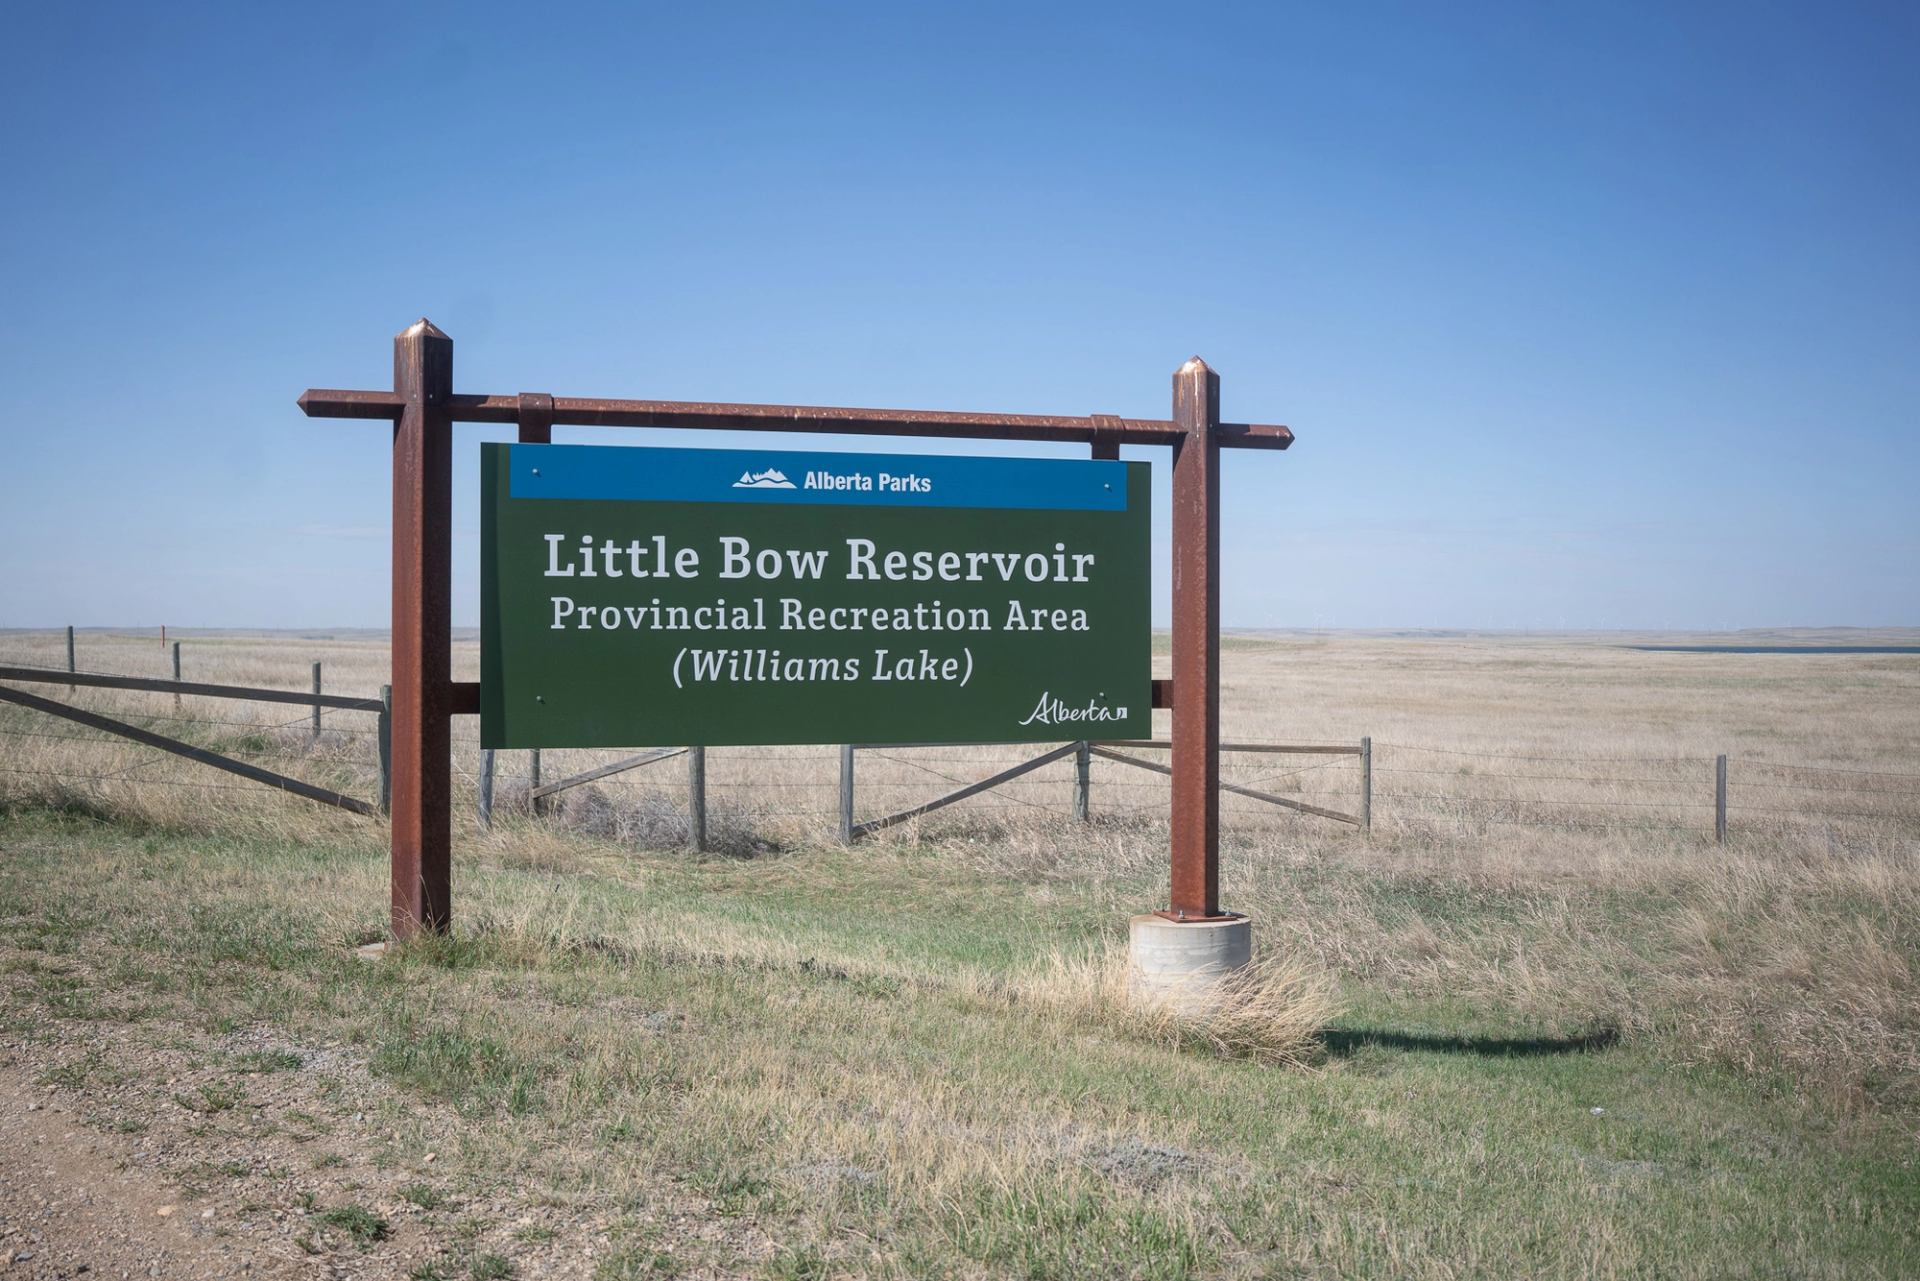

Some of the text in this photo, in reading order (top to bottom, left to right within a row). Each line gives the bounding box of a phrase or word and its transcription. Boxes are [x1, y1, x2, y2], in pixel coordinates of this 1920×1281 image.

[803, 471, 932, 493] Alberta Parks
[543, 533, 1095, 583] Little Bow Reservoir
[550, 596, 1090, 631] Provincial Recreation Area
[673, 647, 974, 688] (Williams Lake)
[1018, 691, 1119, 726] Alberta
